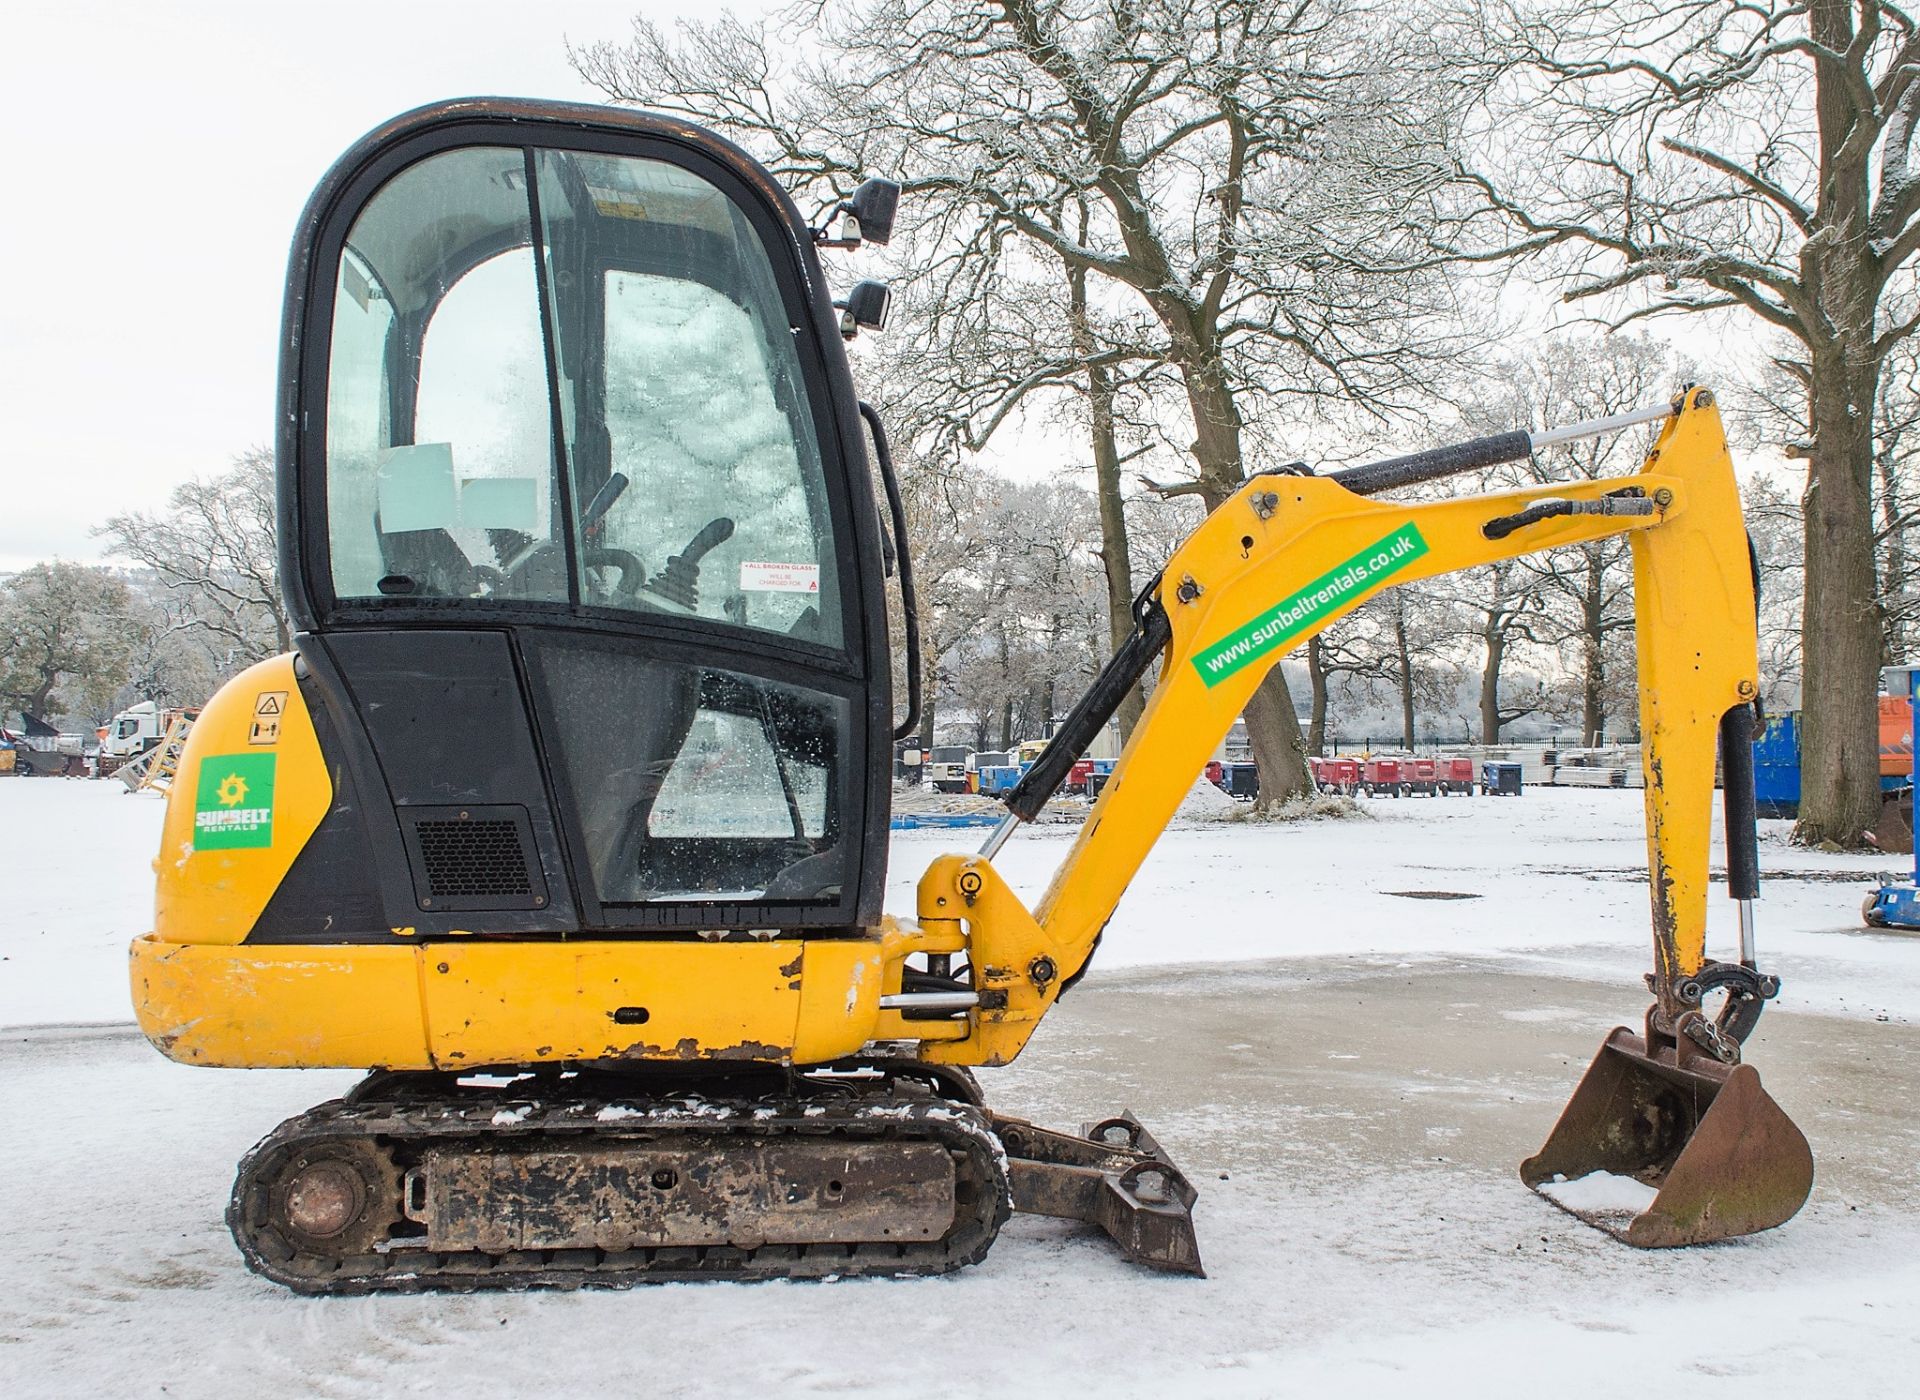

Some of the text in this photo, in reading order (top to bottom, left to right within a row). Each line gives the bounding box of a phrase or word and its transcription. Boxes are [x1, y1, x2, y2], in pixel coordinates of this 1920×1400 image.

[1206, 535, 1416, 673] www.sunbeltrentals.co.uk
[195, 808, 270, 827] SUNBELT
[203, 824, 258, 833] RENTALS
